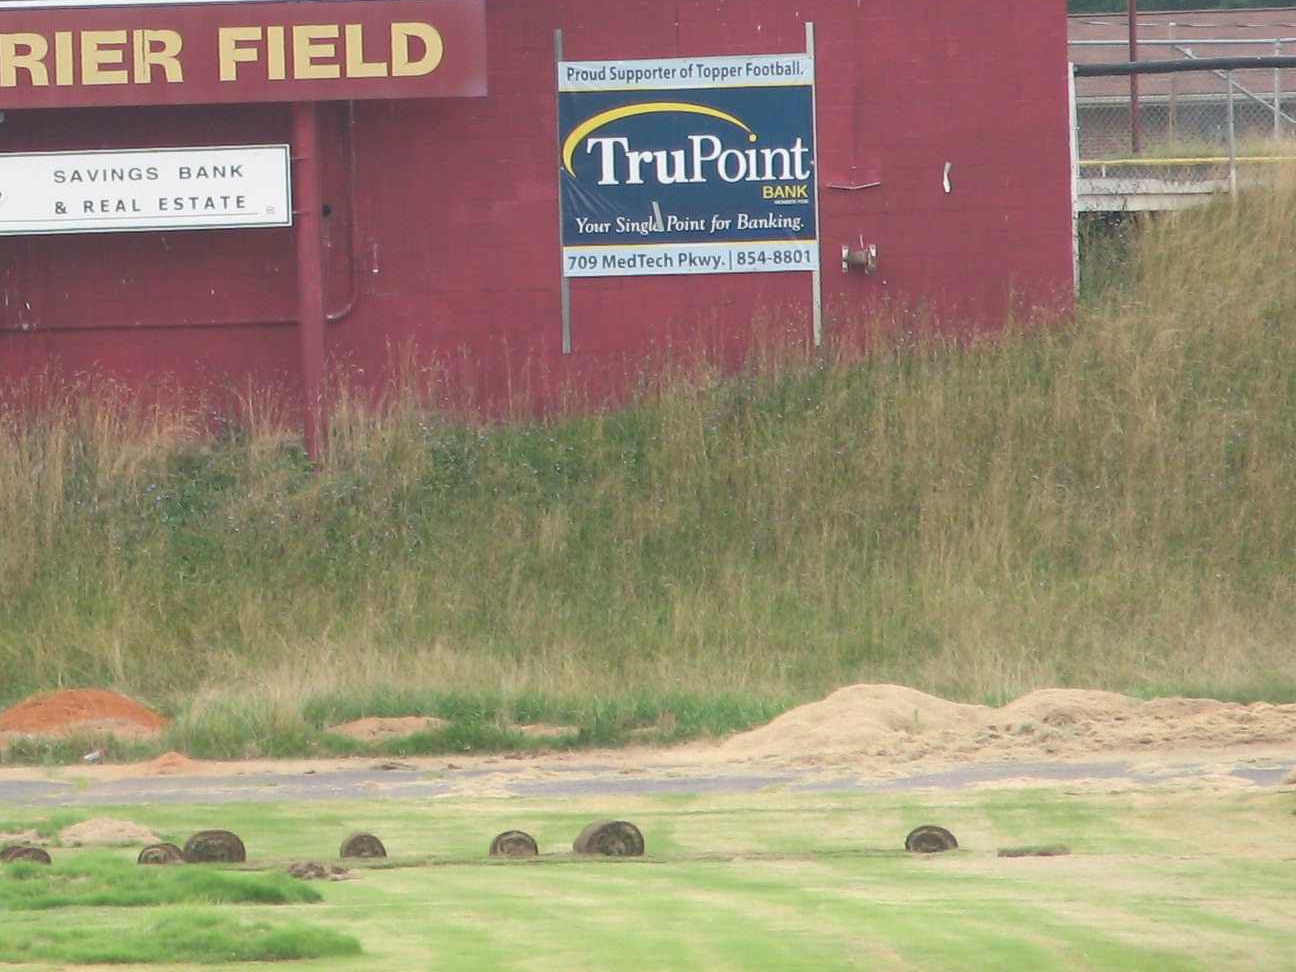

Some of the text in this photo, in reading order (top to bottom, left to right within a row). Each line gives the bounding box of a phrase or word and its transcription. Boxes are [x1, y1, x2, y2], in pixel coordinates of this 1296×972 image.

[218, 21, 443, 83] FIELD
[567, 61, 804, 84] Proud Supporter of Topper Football.
[586, 133, 811, 186] TruPoint
[54, 165, 244, 183] SAVINGS BANK
[762, 185, 808, 199] BANK
[55, 196, 246, 214] & REAL ESTATE
[575, 217, 610, 234] Your
[667, 216, 705, 232] Point
[709, 214, 732, 234] for
[737, 212, 804, 231] Banking.
[568, 250, 812, 271] 709 MedTech Pkwy. 854-8801
